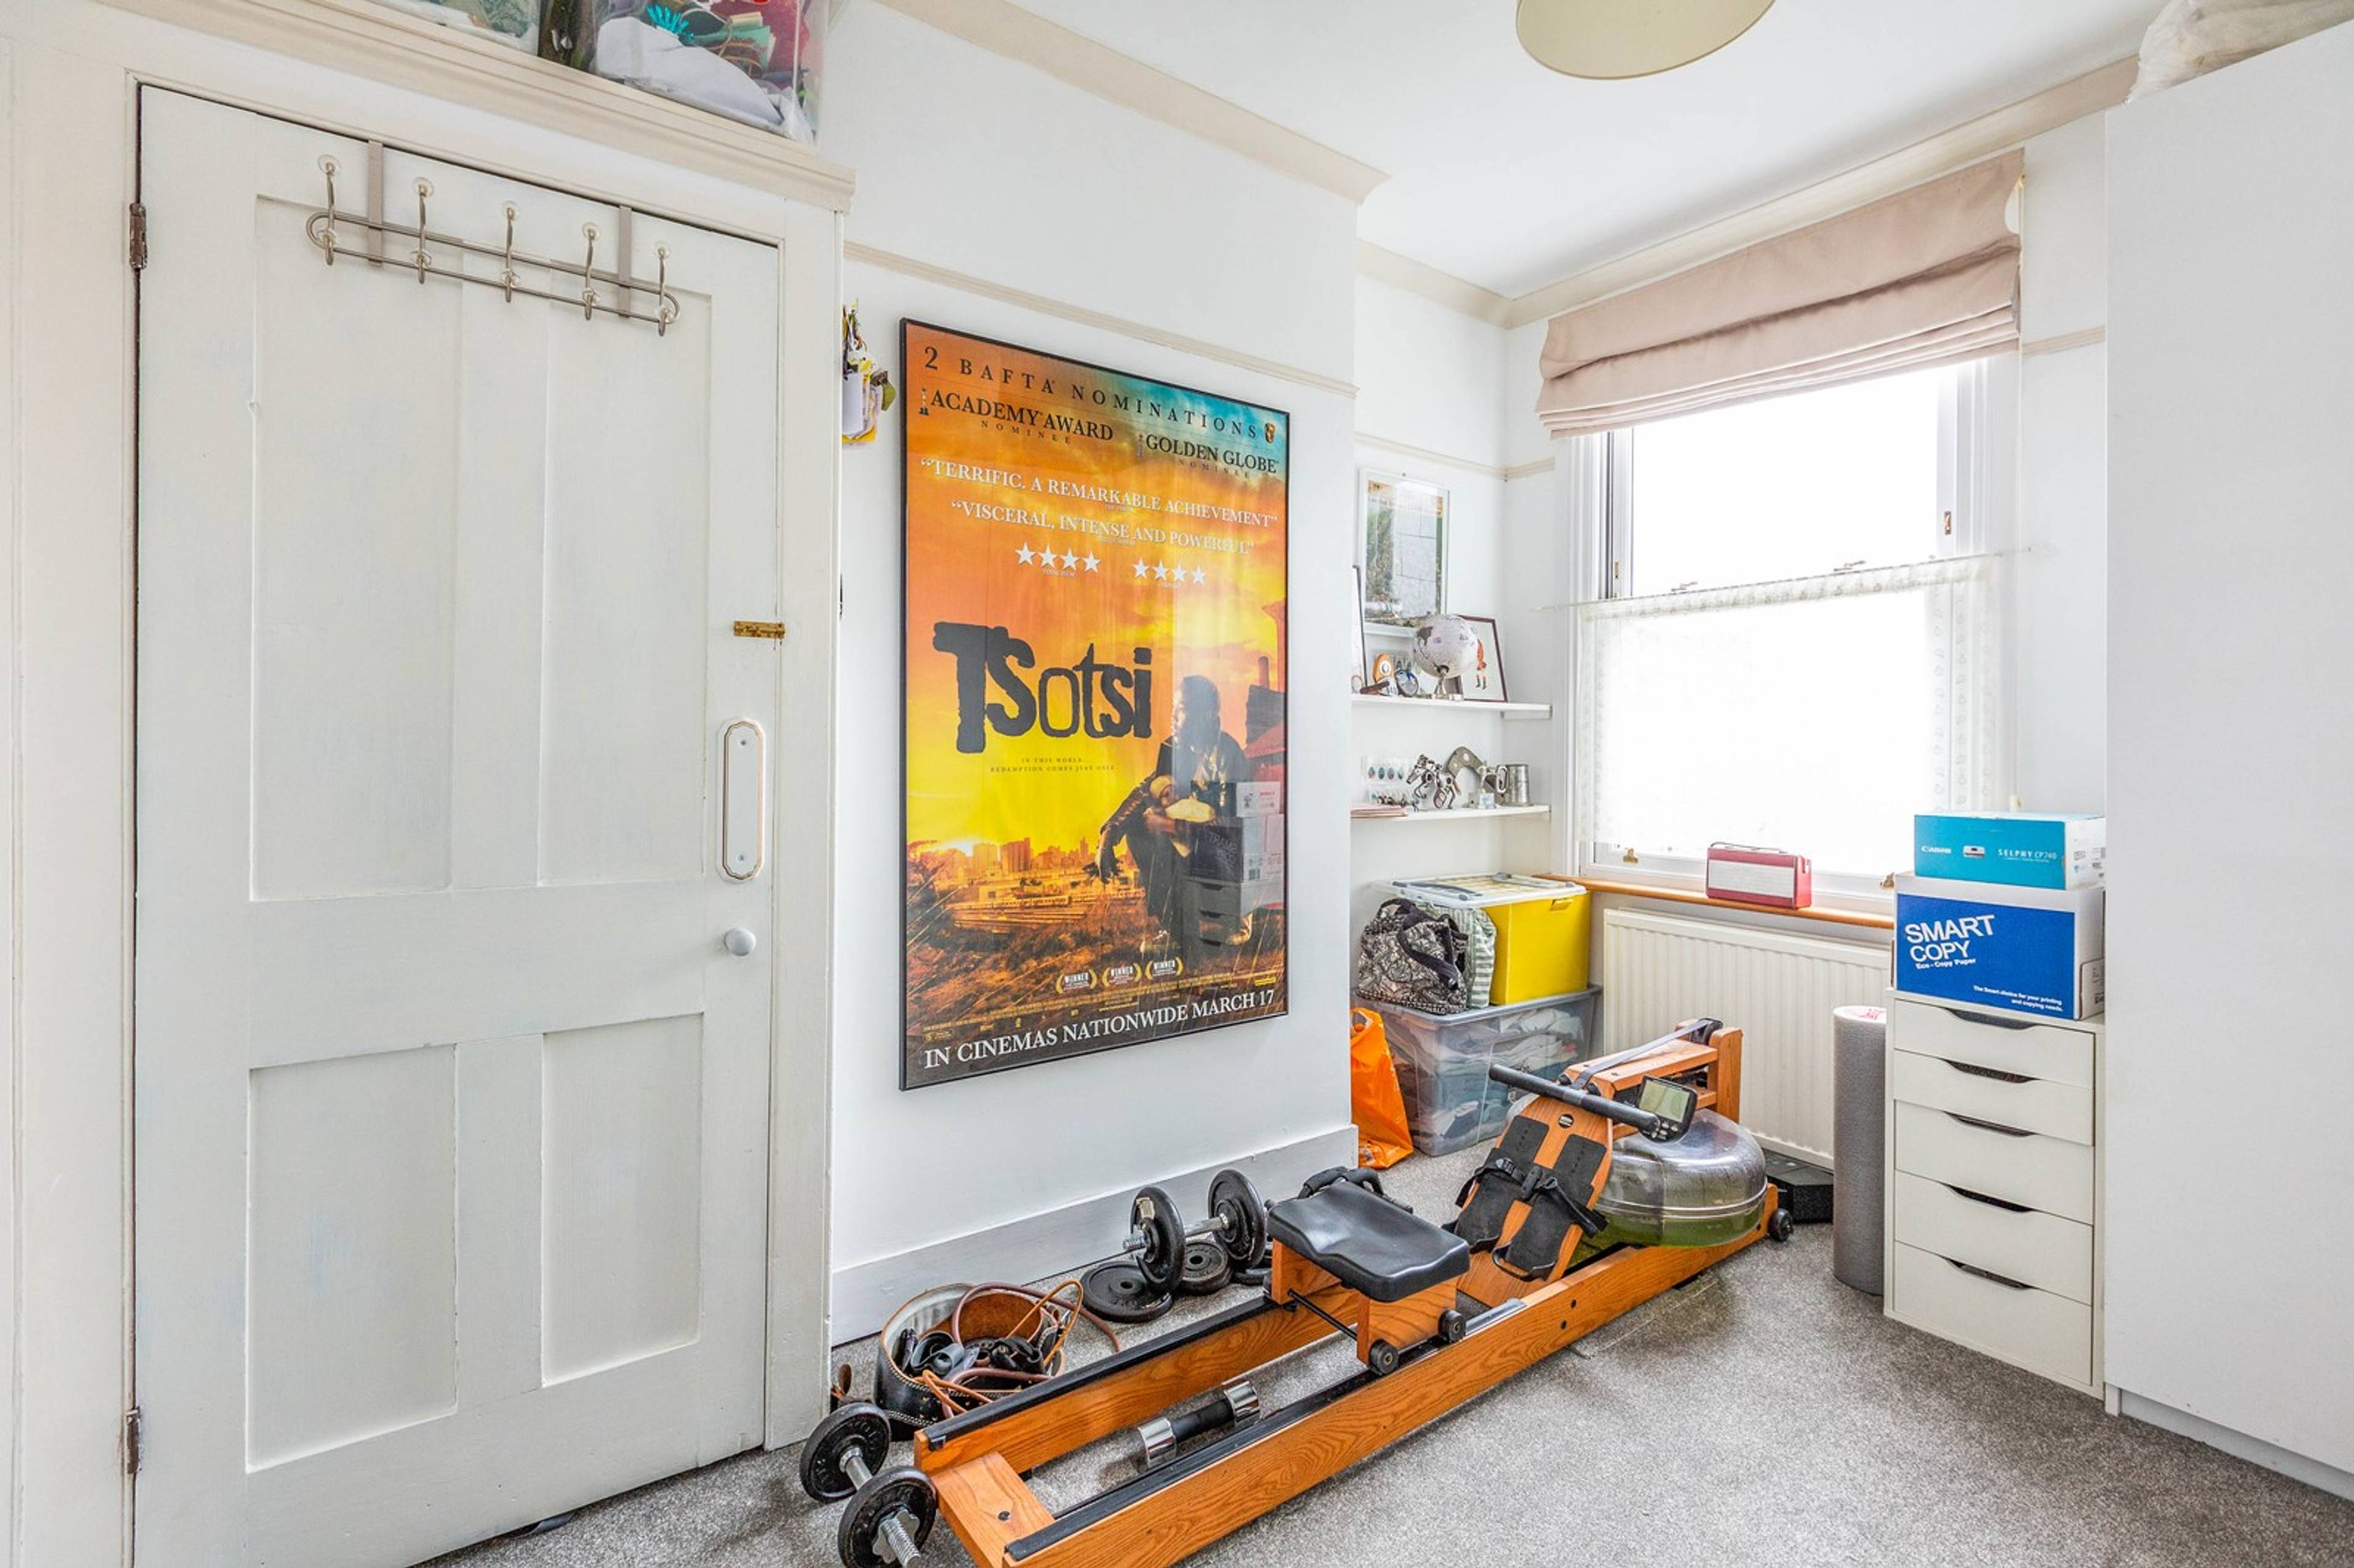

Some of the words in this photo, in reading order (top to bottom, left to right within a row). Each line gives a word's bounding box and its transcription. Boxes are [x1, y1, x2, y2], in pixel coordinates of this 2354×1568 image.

[924, 346, 939, 370] 2
[959, 359, 1054, 394] BAFTA
[1072, 384, 1257, 439] NOMINATIONS
[931, 389, 1038, 427] ACADEMY
[1043, 414, 1114, 441] AWARD
[981, 420, 1070, 444] NOMINEE
[1146, 434, 1219, 462] GOLDEN
[1223, 450, 1278, 474] GLOBE
[1178, 459, 1250, 479] NOMINEE
[1031, 477, 1042, 492] A
[1048, 479, 1161, 510] REMARKABLE
[1059, 516, 1129, 538] INTENSE
[1134, 527, 1166, 542] AND
[1921, 846, 1952, 854] Canon
[1998, 849, 2033, 858] SELPHY
[1905, 914, 1995, 943] SMART
[1910, 940, 1970, 962] COPY
[1954, 958, 1976, 967] Paper
[2023, 1000, 2044, 1010] copying
[2040, 997, 2062, 1006] printing
[924, 1047, 951, 1069] IN
[957, 1028, 1057, 1062] CINEMAS
[1062, 1005, 1188, 1043] NATIONWIDE
[1192, 994, 1255, 1019] MARCH
[1259, 989, 1275, 1007] 17
